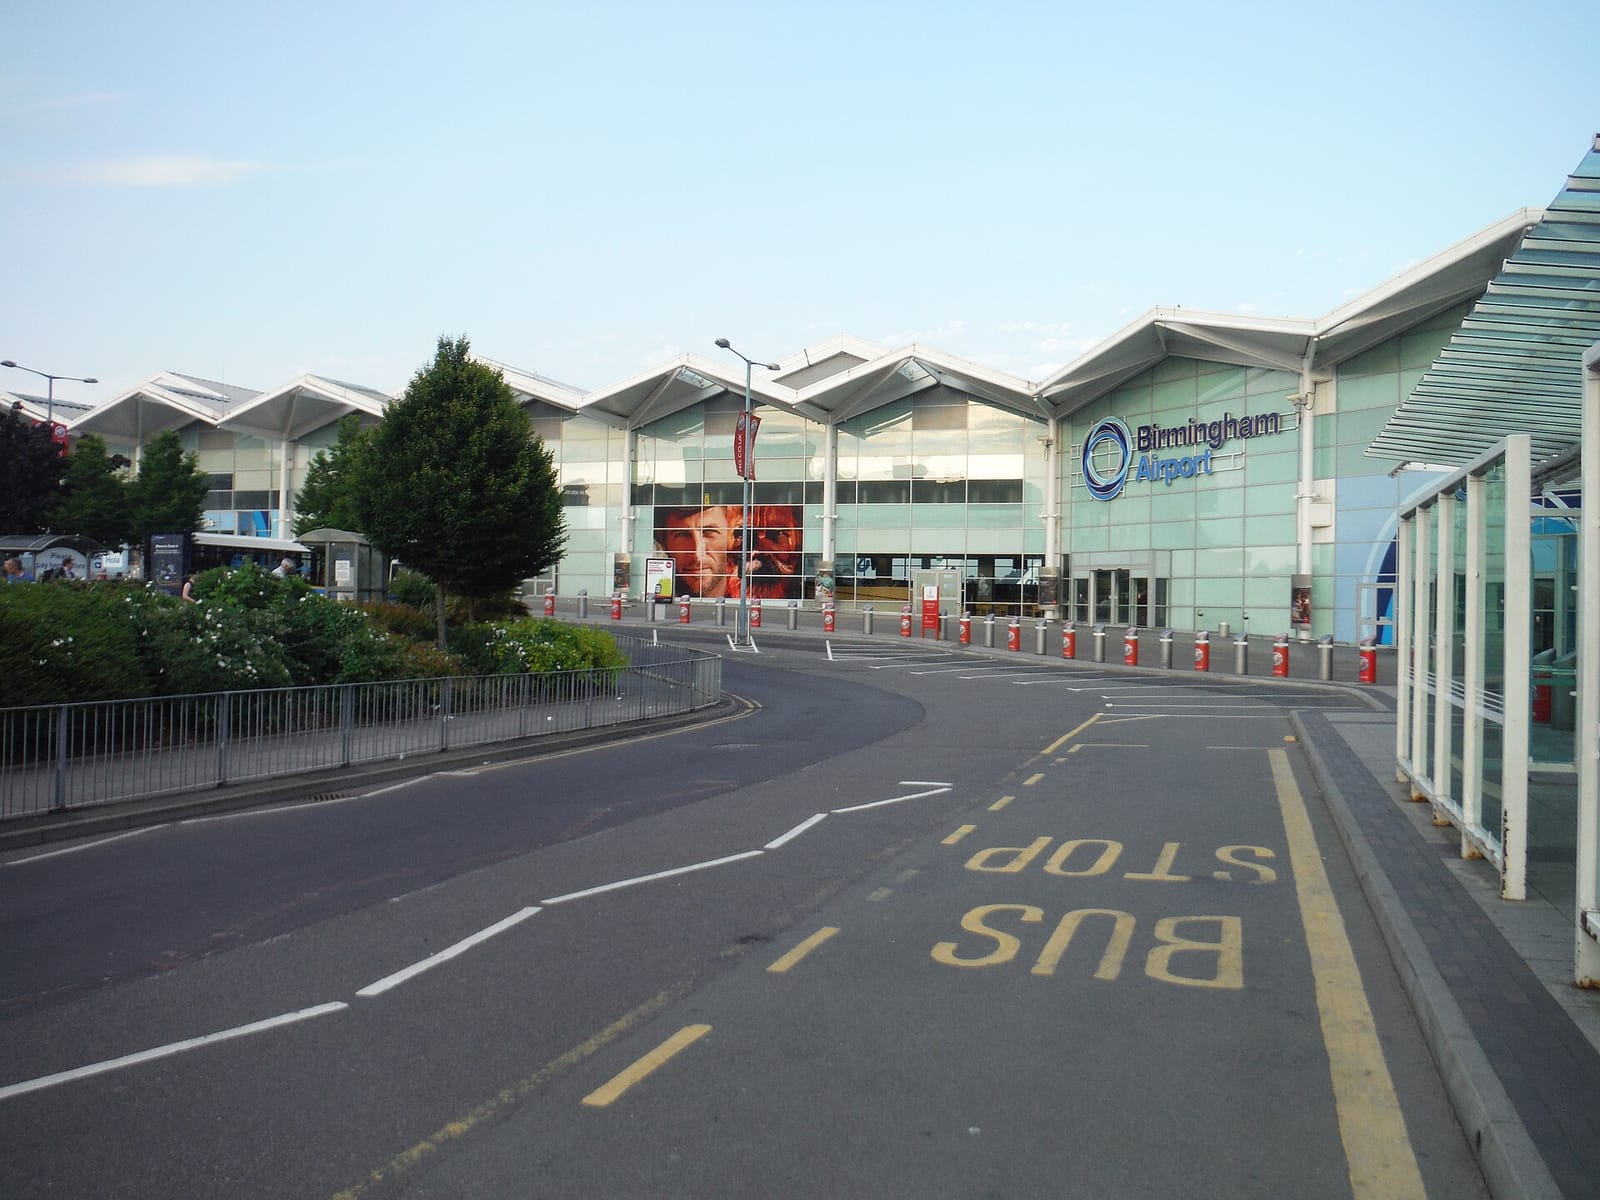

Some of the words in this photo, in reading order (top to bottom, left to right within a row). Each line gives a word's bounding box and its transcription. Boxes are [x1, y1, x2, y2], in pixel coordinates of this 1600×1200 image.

[1137, 412, 1280, 451] Birmingham
[1135, 449, 1213, 486] Airport
[964, 836, 1277, 884] STOP
[930, 903, 1244, 988] BUS
